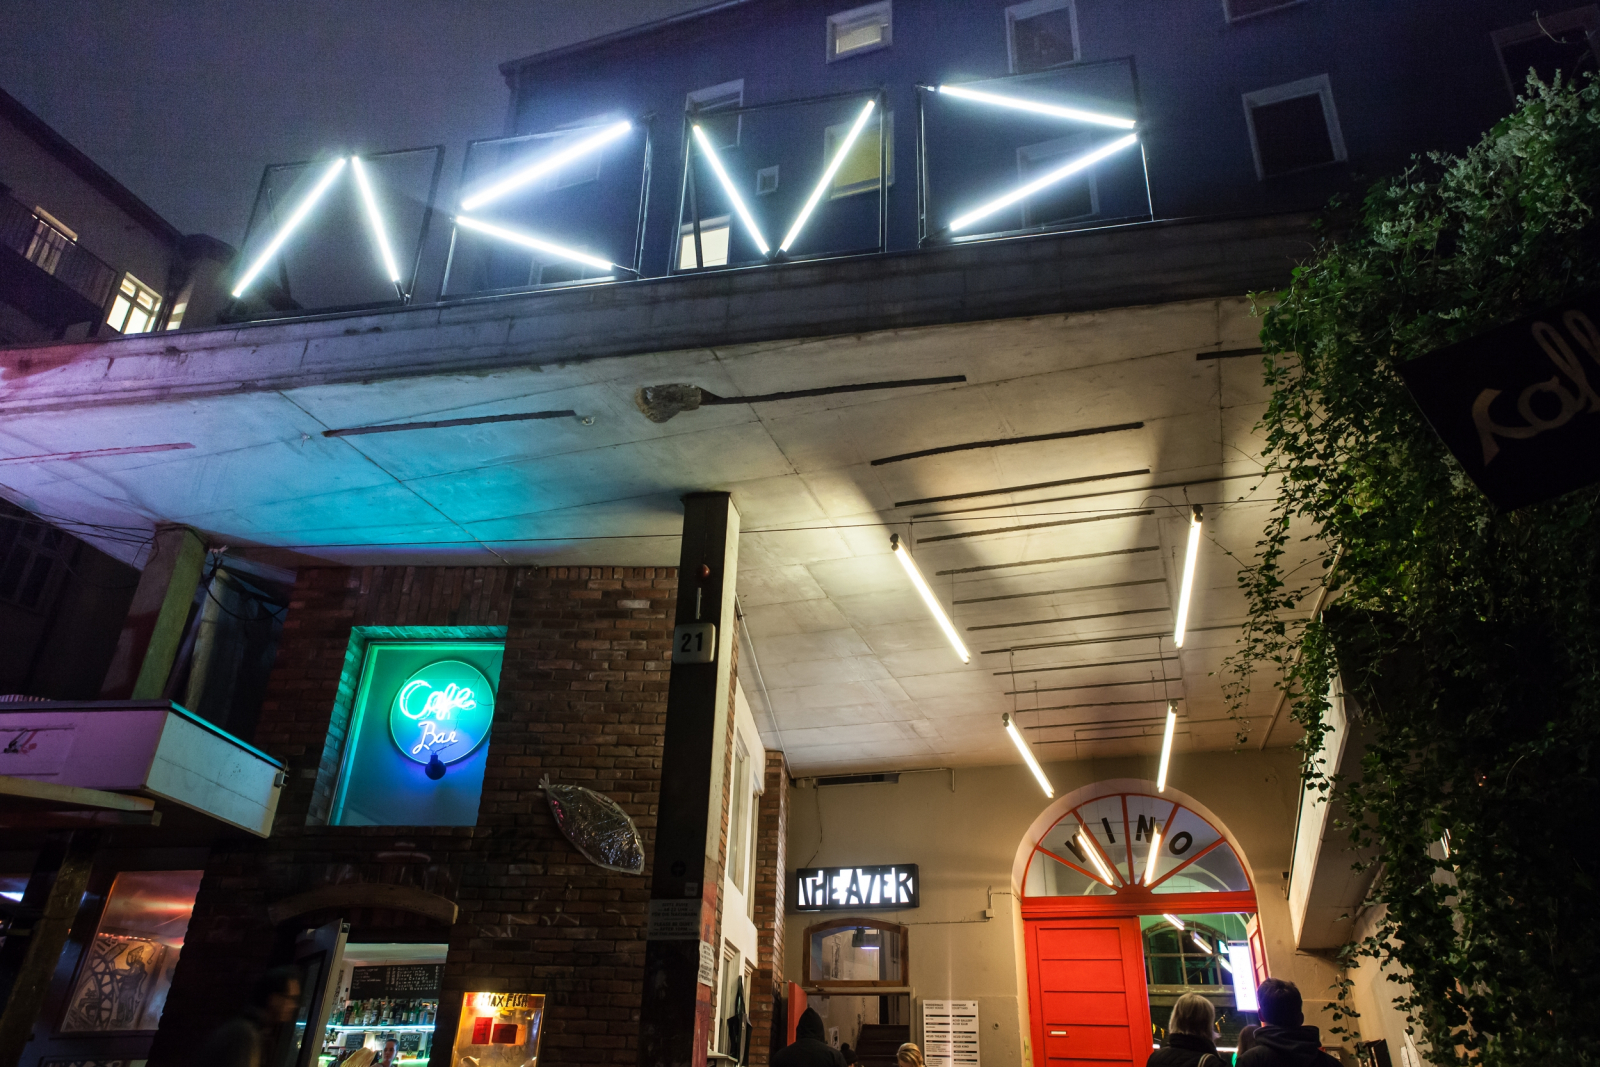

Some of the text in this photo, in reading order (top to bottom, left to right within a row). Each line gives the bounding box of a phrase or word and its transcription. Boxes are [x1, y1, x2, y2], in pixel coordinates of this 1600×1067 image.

[681, 632, 703, 653] 21
[412, 721, 459, 755] Bar
[1064, 814, 1193, 863] KINO
[798, 867, 915, 906] THEATER
[505, 993, 529, 1007] FISH
